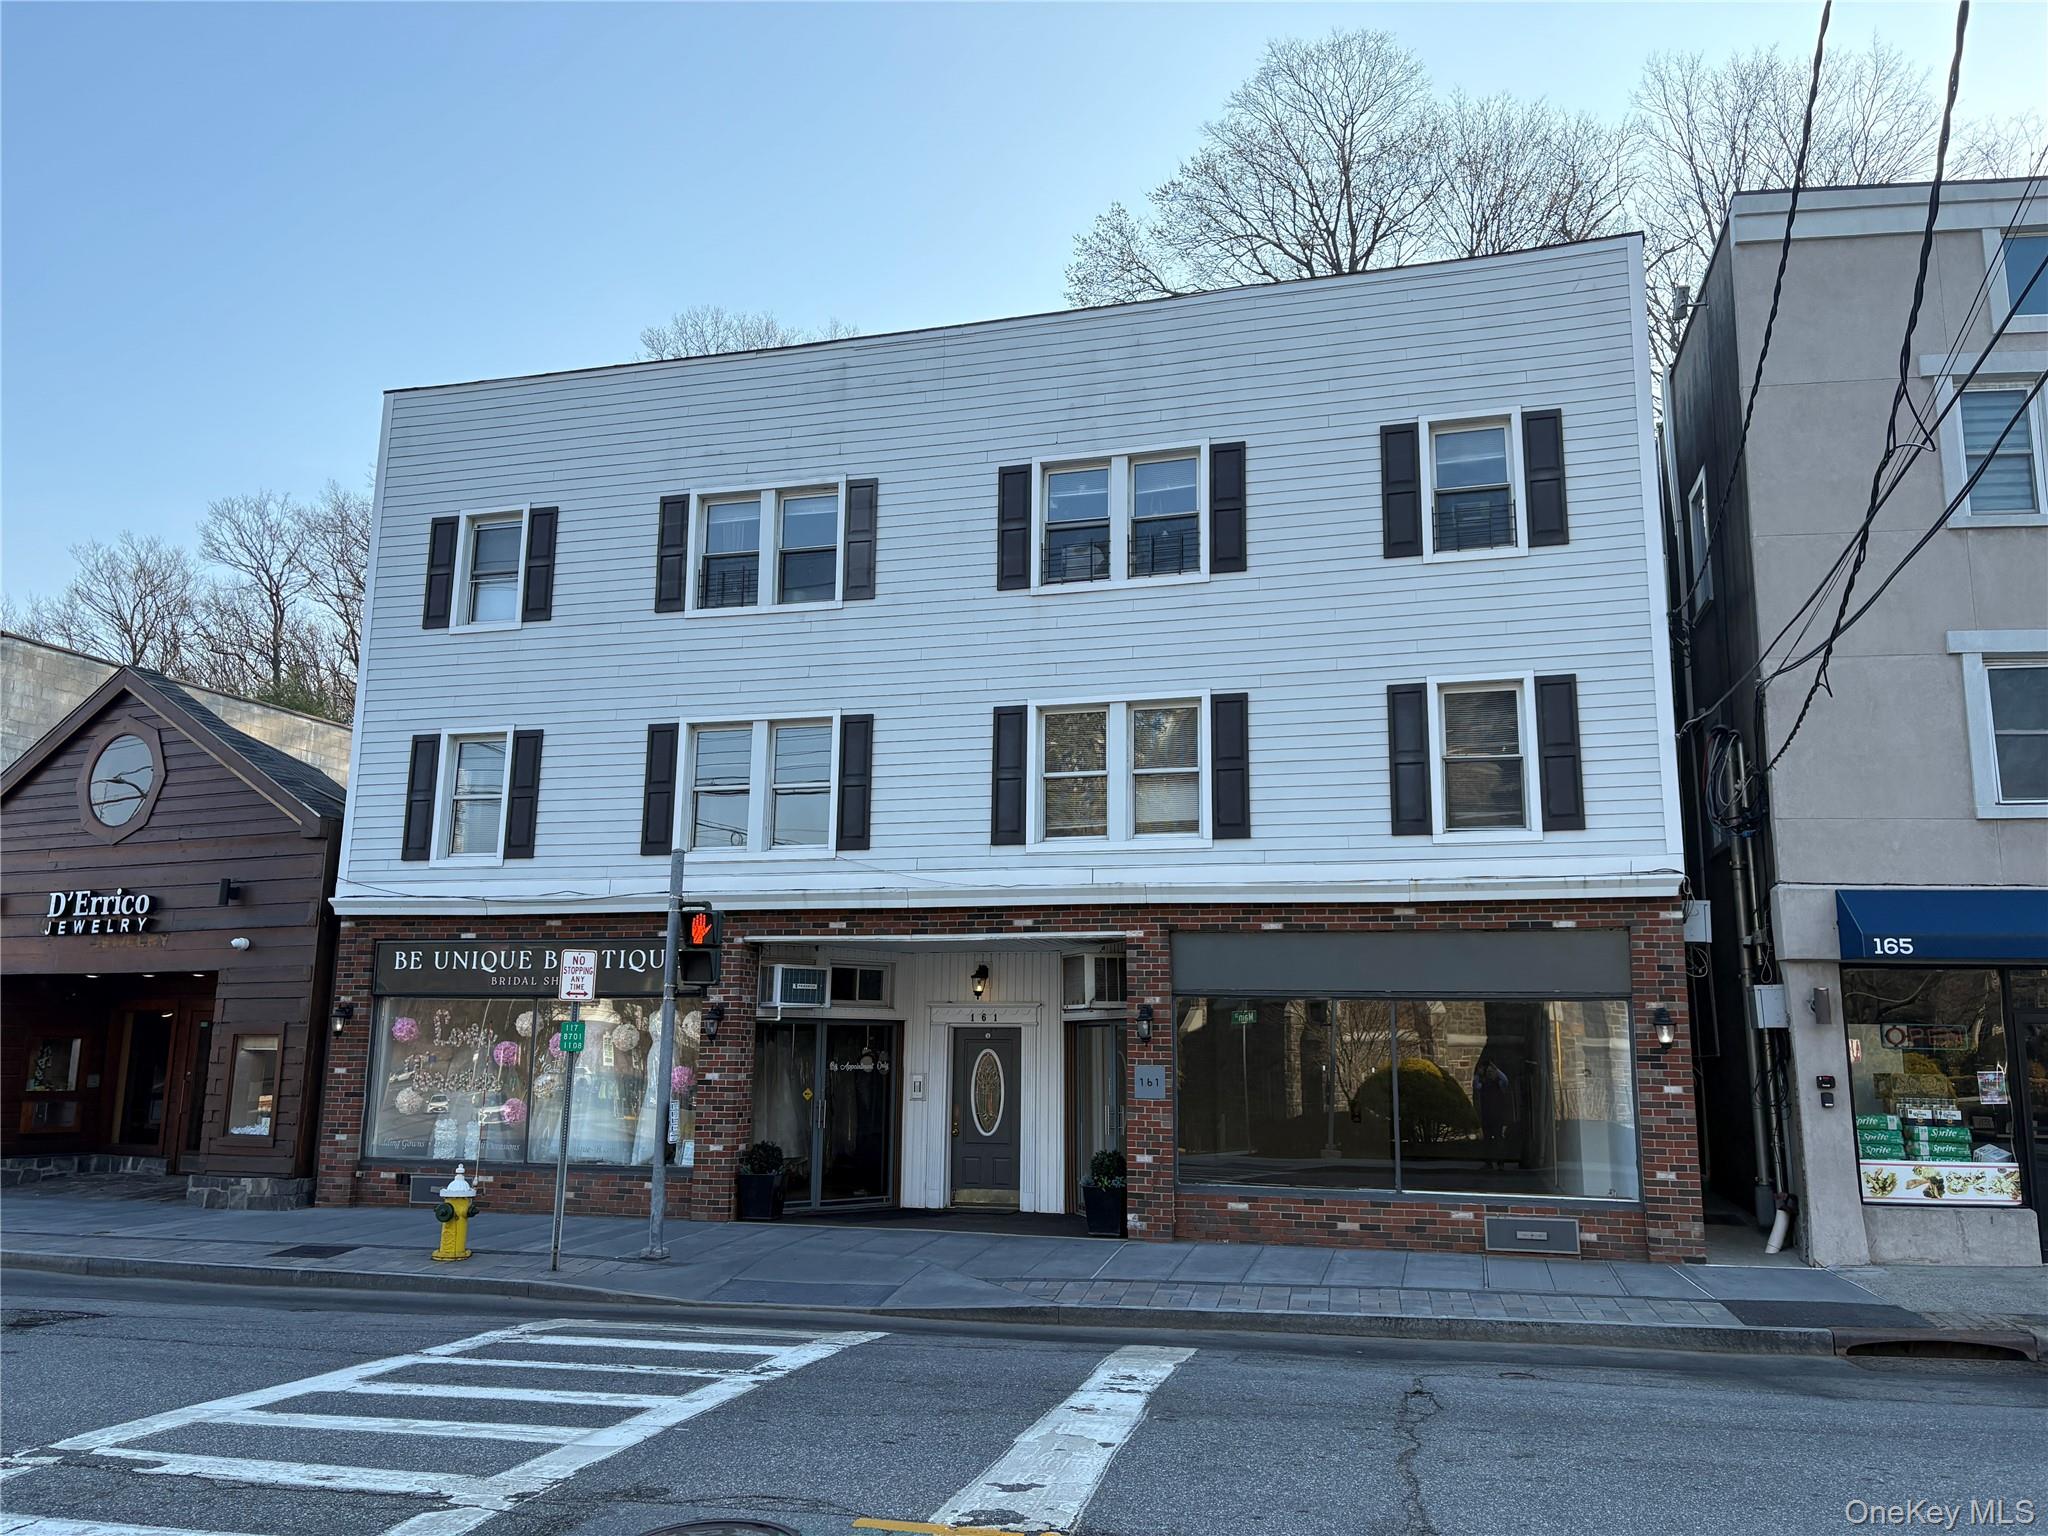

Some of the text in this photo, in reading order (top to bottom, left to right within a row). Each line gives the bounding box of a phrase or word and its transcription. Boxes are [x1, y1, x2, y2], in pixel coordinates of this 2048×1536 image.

[47, 888, 150, 918] D'Errico
[44, 917, 147, 935] JEWELRY
[1873, 938, 1914, 955] 165
[394, 949, 682, 973] BE UNIQUE BTIQU
[572, 955, 586, 966] NO
[563, 967, 594, 976] STOPPING
[491, 976, 537, 986] BRIDAL
[570, 975, 585, 983] ANY
[570, 983, 585, 991] TIME
[971, 1013, 998, 1022] 161
[565, 1024, 579, 1032] 117
[563, 1033, 582, 1041] 8701
[1140, 1077, 1159, 1087] 161
[1863, 1133, 1888, 1142] Sprite
[1931, 1128, 1957, 1138] Sprite
[1865, 1145, 1891, 1155] Sprite
[1933, 1144, 1957, 1154] Sprite
